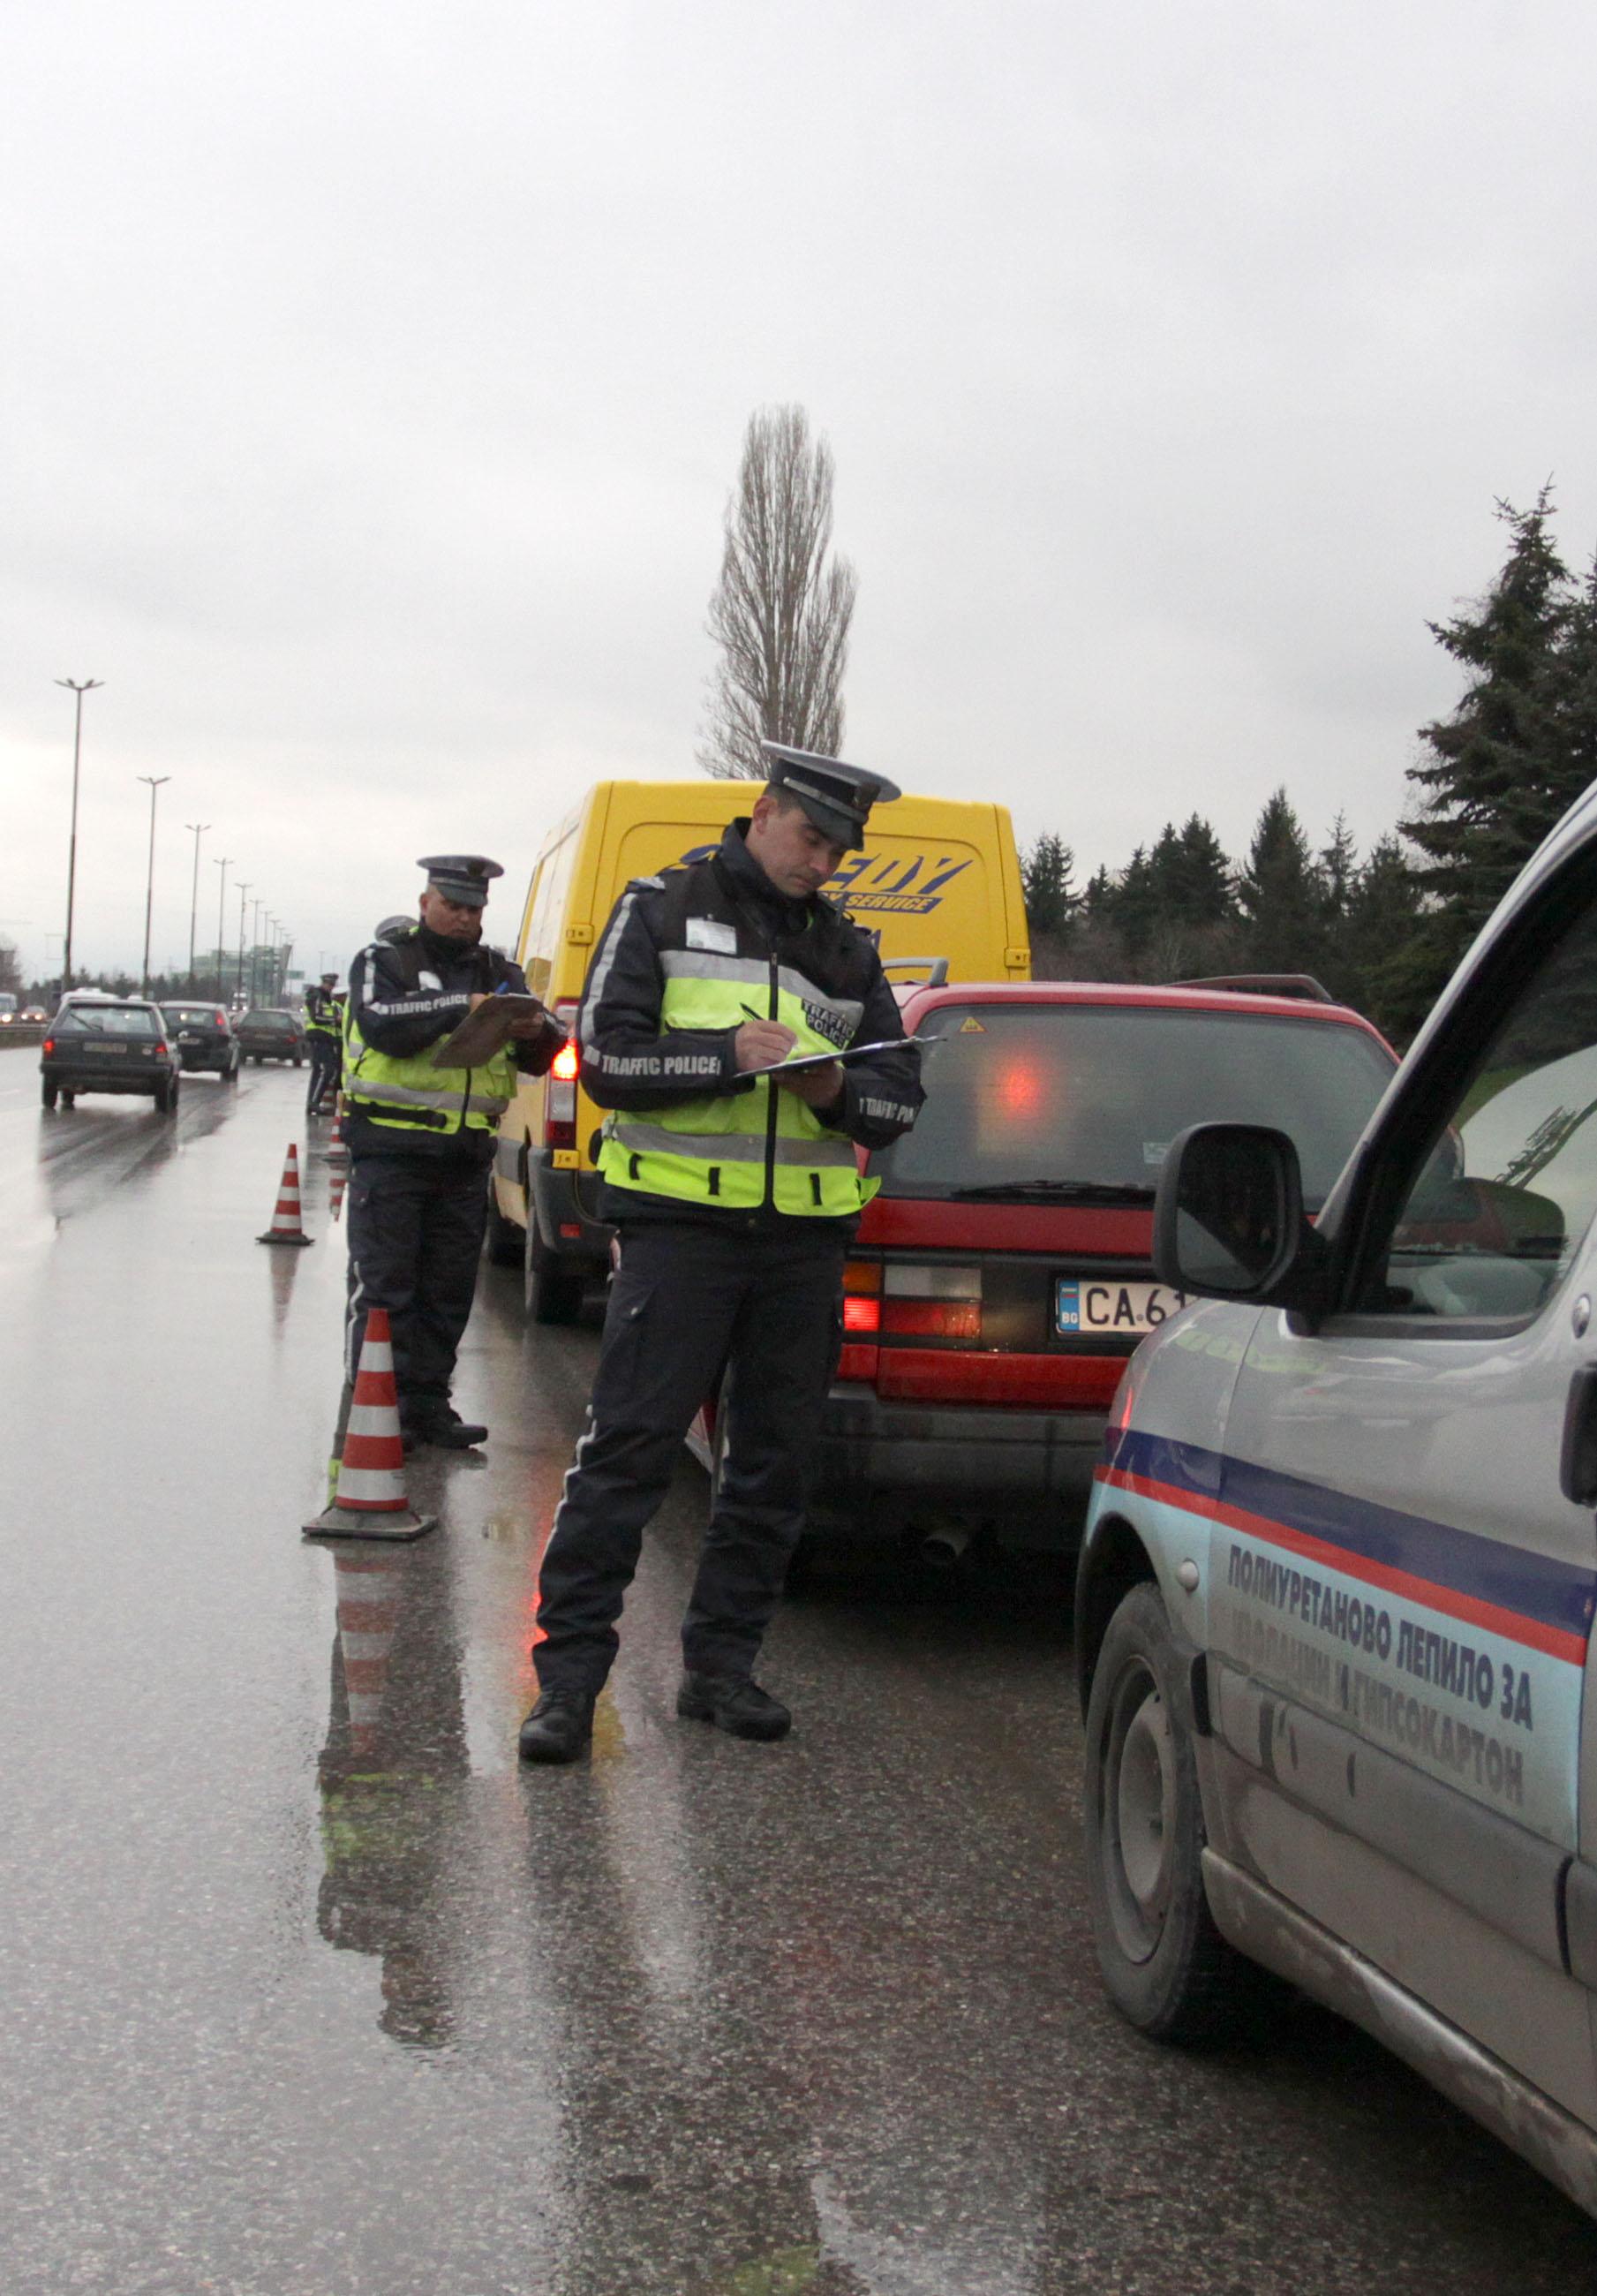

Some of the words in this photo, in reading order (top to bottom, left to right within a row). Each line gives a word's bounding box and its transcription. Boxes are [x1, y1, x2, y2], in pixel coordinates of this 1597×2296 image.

[847, 894, 932, 910] SERVICE
[390, 1001, 432, 1015] TRAFFIC
[433, 993, 468, 1009] POLICE
[803, 1001, 854, 1038] TRAFFIC
[807, 1016, 847, 1046] POLICE
[601, 1054, 660, 1076] TRAFFIC
[664, 1056, 718, 1075] POLICE
[1061, 1312, 1078, 1324] BG
[1228, 1545, 1392, 1661] ПОЛИУРЕТАНОВО
[1396, 1619, 1494, 1710] ЛЕПИЛО
[1500, 1663, 1533, 1731] ЗА
